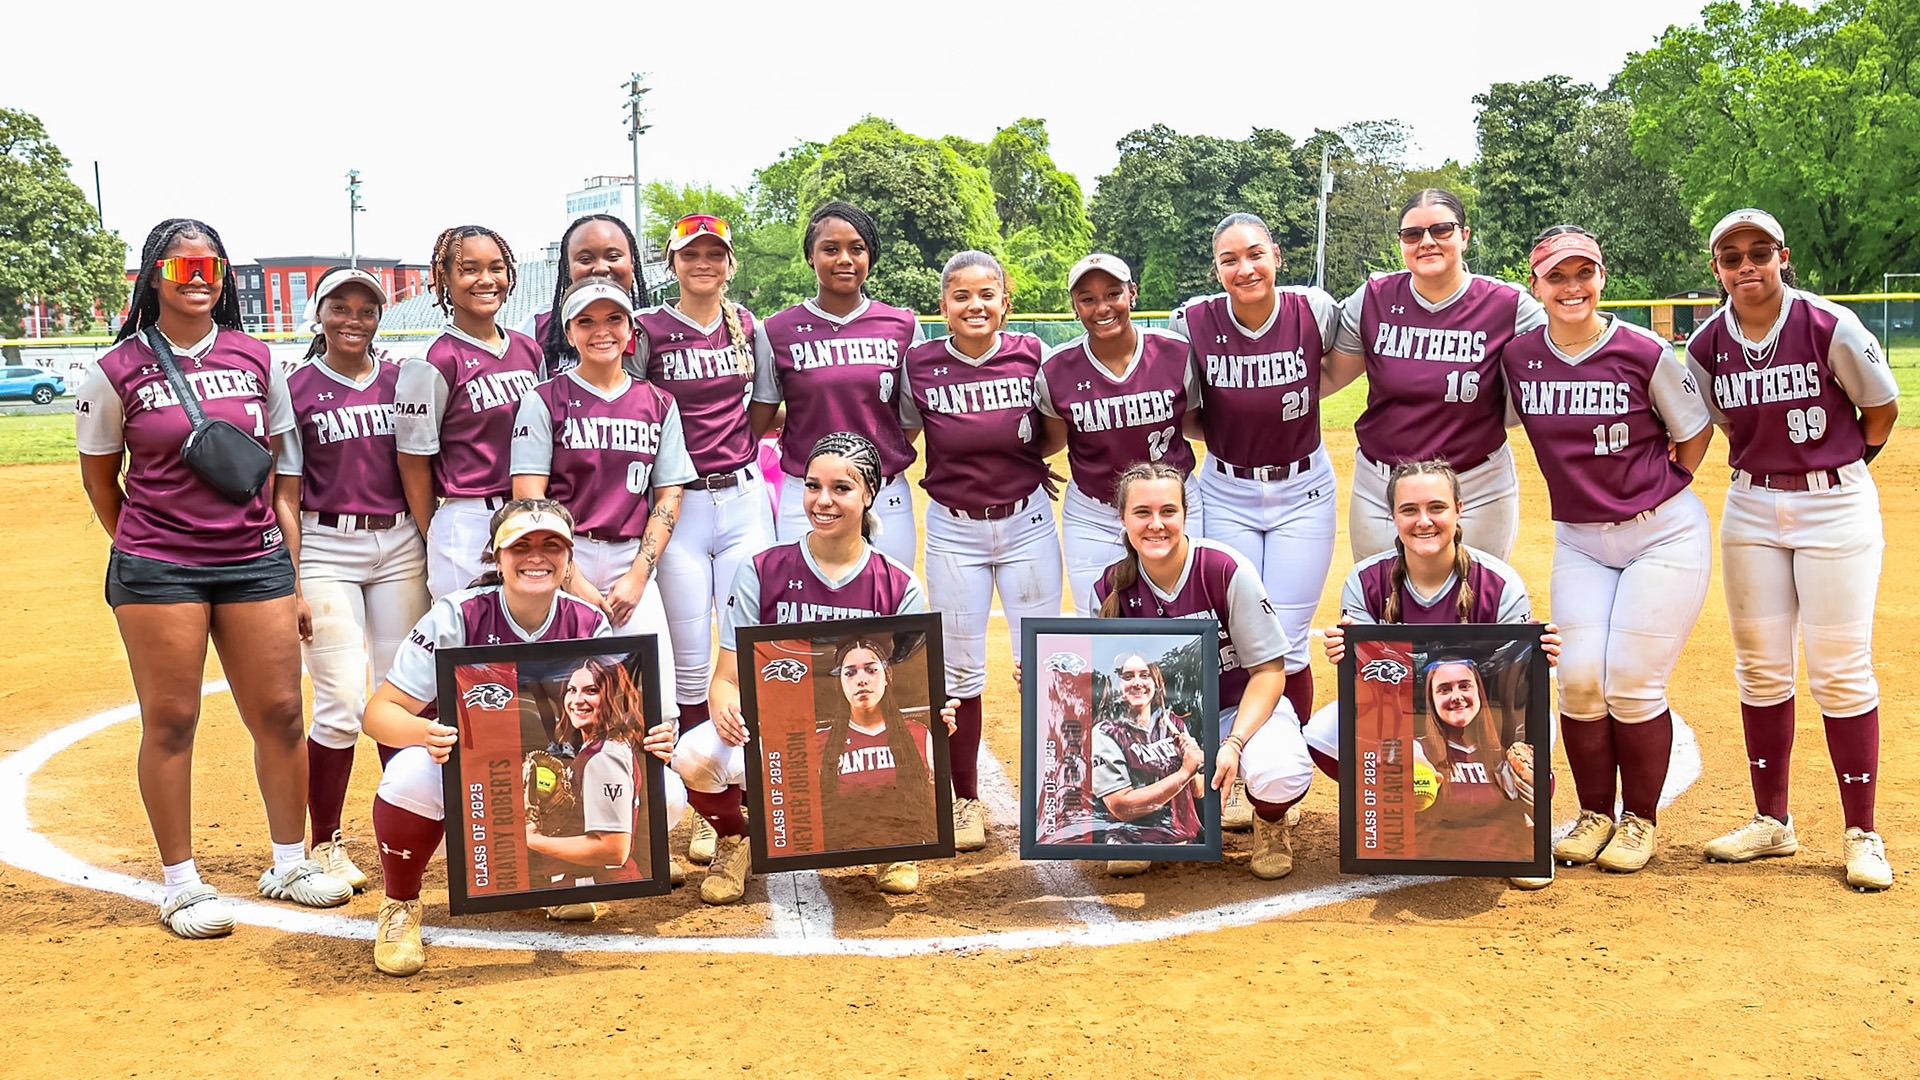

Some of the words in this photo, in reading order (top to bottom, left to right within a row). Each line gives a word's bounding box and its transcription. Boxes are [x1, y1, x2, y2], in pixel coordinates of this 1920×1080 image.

[789, 338, 899, 371] PANTHERS
[1373, 322, 1487, 363] PANTHERS
[1206, 347, 1308, 388] PANTHERS
[1714, 362, 1821, 409] PANTHERS
[879, 372, 895, 402] 8
[925, 377, 1032, 414] PANTHERS
[1281, 386, 1310, 421] 21
[1444, 370, 1481, 403] 16
[1519, 381, 1630, 415] PANTHERS
[246, 403, 265, 437] 7
[311, 404, 396, 444] PANTHE
[1018, 413, 1033, 443] 4
[1070, 389, 1176, 432] PANTHERS
[1786, 405, 1827, 444] 99
[562, 417, 662, 456] PANTHERS
[1593, 422, 1629, 455] 10
[768, 751, 783, 785] 2025
[786, 731, 810, 794] JOHNSON
[1044, 740, 1056, 772] 2025
[1364, 751, 1376, 785] 2025
[1381, 738, 1404, 803] GARLAND
[470, 783, 485, 819] 2025
[488, 758, 514, 826] ROBERTS
[771, 788, 784, 805] OF
[1044, 776, 1056, 793] OF
[1364, 789, 1376, 806] OF
[472, 823, 486, 841] OF
[773, 809, 787, 848] CLASS
[791, 798, 814, 852] NEVAEH
[1045, 797, 1056, 835] CLASS
[1364, 810, 1377, 849] CLASS
[1383, 808, 1405, 855] KALLIE
[473, 845, 489, 887] CLASS
[494, 831, 518, 891] BRANDY
